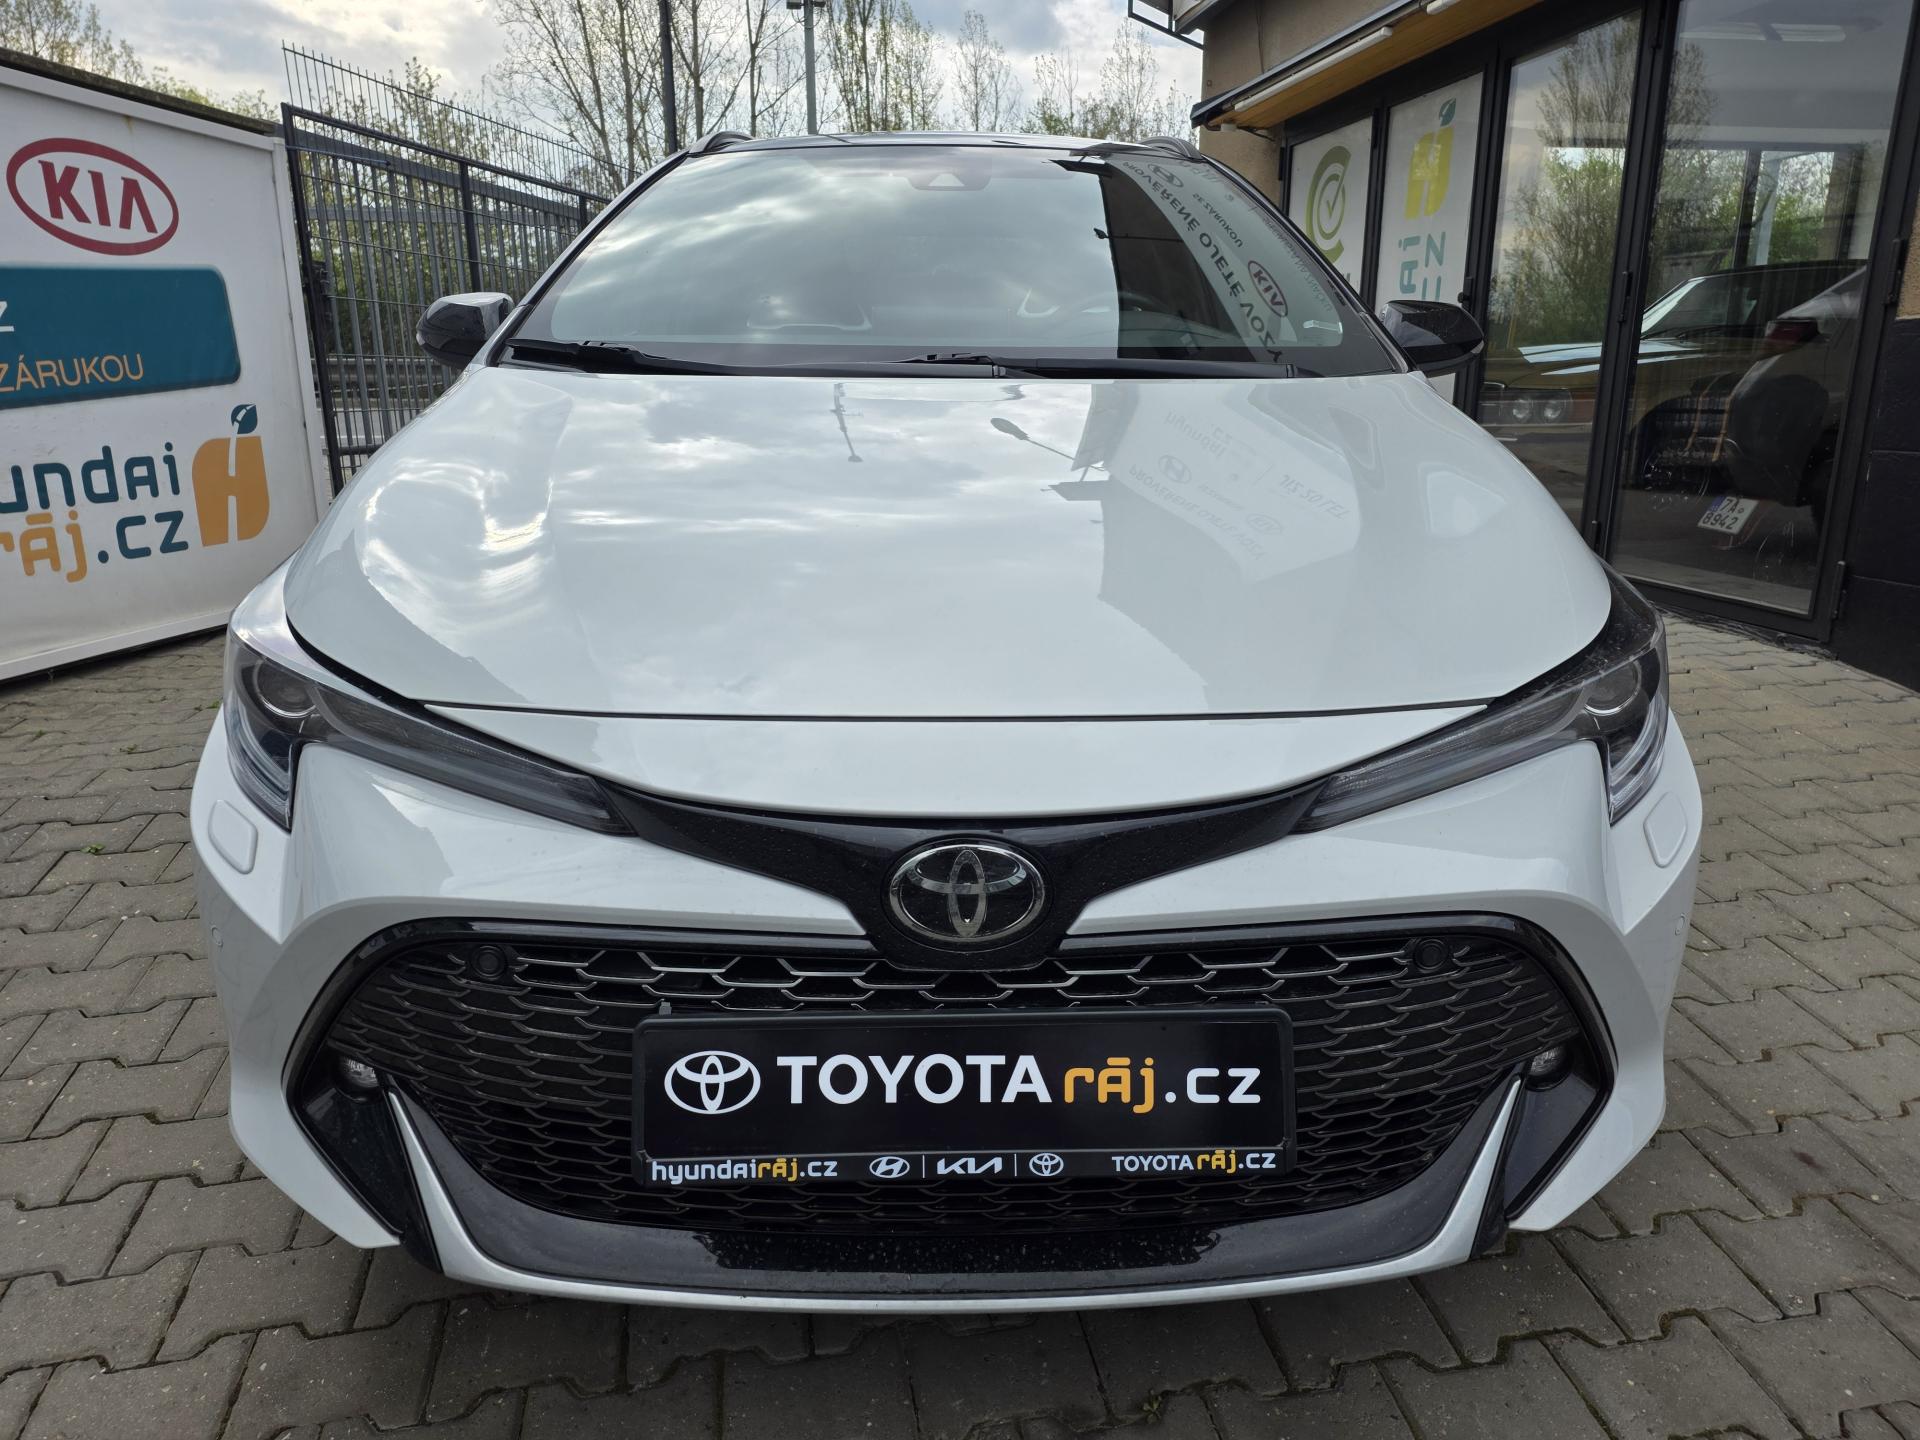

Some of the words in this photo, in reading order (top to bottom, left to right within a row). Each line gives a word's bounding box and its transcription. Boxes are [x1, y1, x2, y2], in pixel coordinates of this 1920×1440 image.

[38, 160, 158, 234] KIA
[0, 354, 144, 392] ZÁRUKOU
[777, 1053, 1053, 1105] TOYOTA
